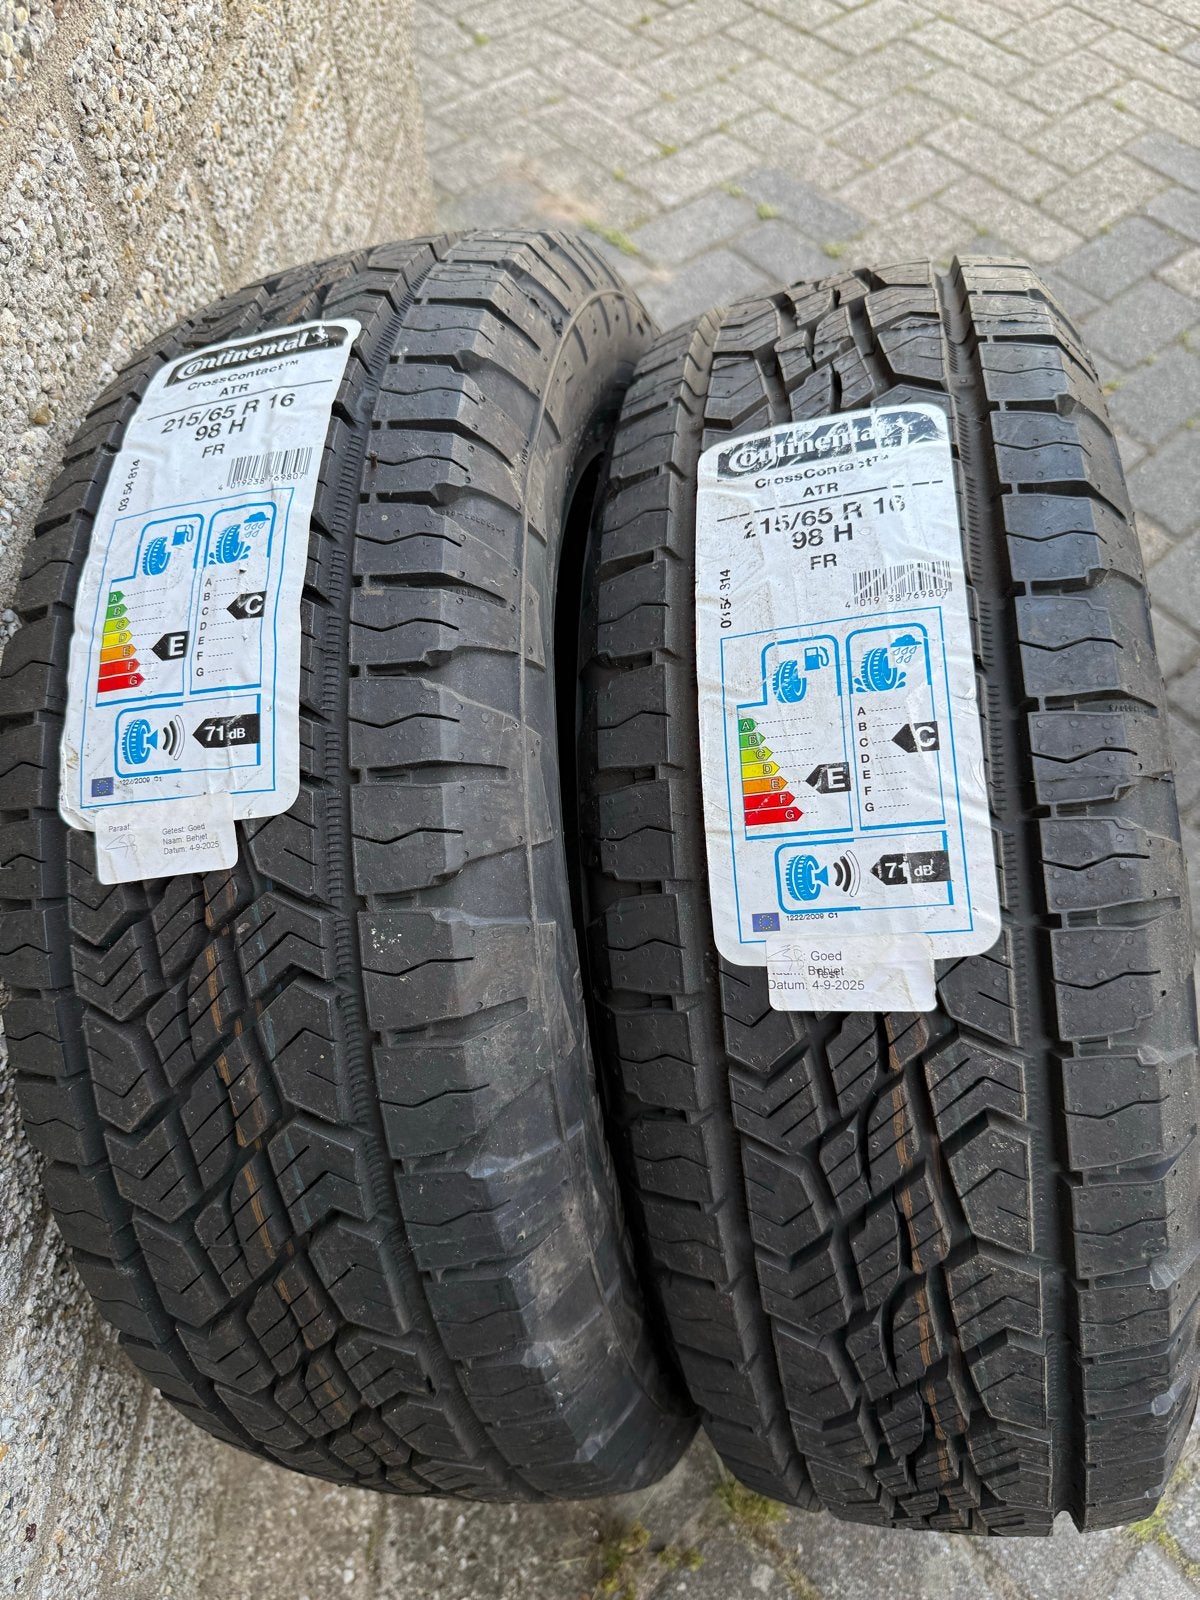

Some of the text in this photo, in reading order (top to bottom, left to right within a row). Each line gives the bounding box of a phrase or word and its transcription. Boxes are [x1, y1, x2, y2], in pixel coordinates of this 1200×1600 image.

[176, 332, 311, 380] Continental
[219, 383, 249, 397] ATR
[161, 393, 296, 434] 215/65 R 16
[194, 418, 247, 441] 98 H
[202, 443, 226, 459] FR
[728, 420, 884, 473] Continenta
[118, 493, 130, 512] 03
[128, 459, 141, 481] 814
[802, 482, 839, 497] ATR
[743, 494, 906, 540] 215/65 R 16
[791, 522, 853, 550] 98 H
[810, 553, 837, 570] FR
[204, 578, 213, 587] A
[110, 594, 118, 603] A
[203, 592, 211, 601] B
[859, 593, 901, 608] 01938
[906, 588, 949, 601] 769807
[244, 595, 263, 615] C
[113, 607, 121, 616] B
[201, 607, 210, 616] C
[115, 620, 125, 630] C
[199, 622, 207, 631] D
[118, 633, 127, 643] D
[198, 636, 205, 645] E
[122, 646, 131, 657] E
[169, 636, 185, 657] E
[196, 651, 204, 661] F
[127, 661, 134, 671] F
[195, 667, 204, 677] G
[129, 676, 138, 686] G
[857, 706, 866, 716] A
[741, 721, 751, 730] A
[858, 722, 867, 731] B
[204, 725, 246, 742] 71 dB
[916, 725, 937, 748] C
[748, 735, 757, 745] B
[859, 738, 869, 747] C
[755, 749, 765, 759] C
[861, 754, 870, 763] D
[763, 764, 772, 774] D
[863, 769, 871, 779] E
[826, 767, 845, 789] E
[770, 779, 780, 790] E
[864, 786, 872, 796] F
[779, 794, 787, 804] F
[865, 802, 875, 812] G
[785, 809, 795, 819] G
[187, 823, 206, 833] Goed
[189, 840, 220, 851] 4-9-2025
[884, 862, 934, 879] 71 dB
[827, 911, 839, 919] C1
[810, 950, 842, 961] Goed
[768, 979, 865, 991] Datum: 4-9-2025
